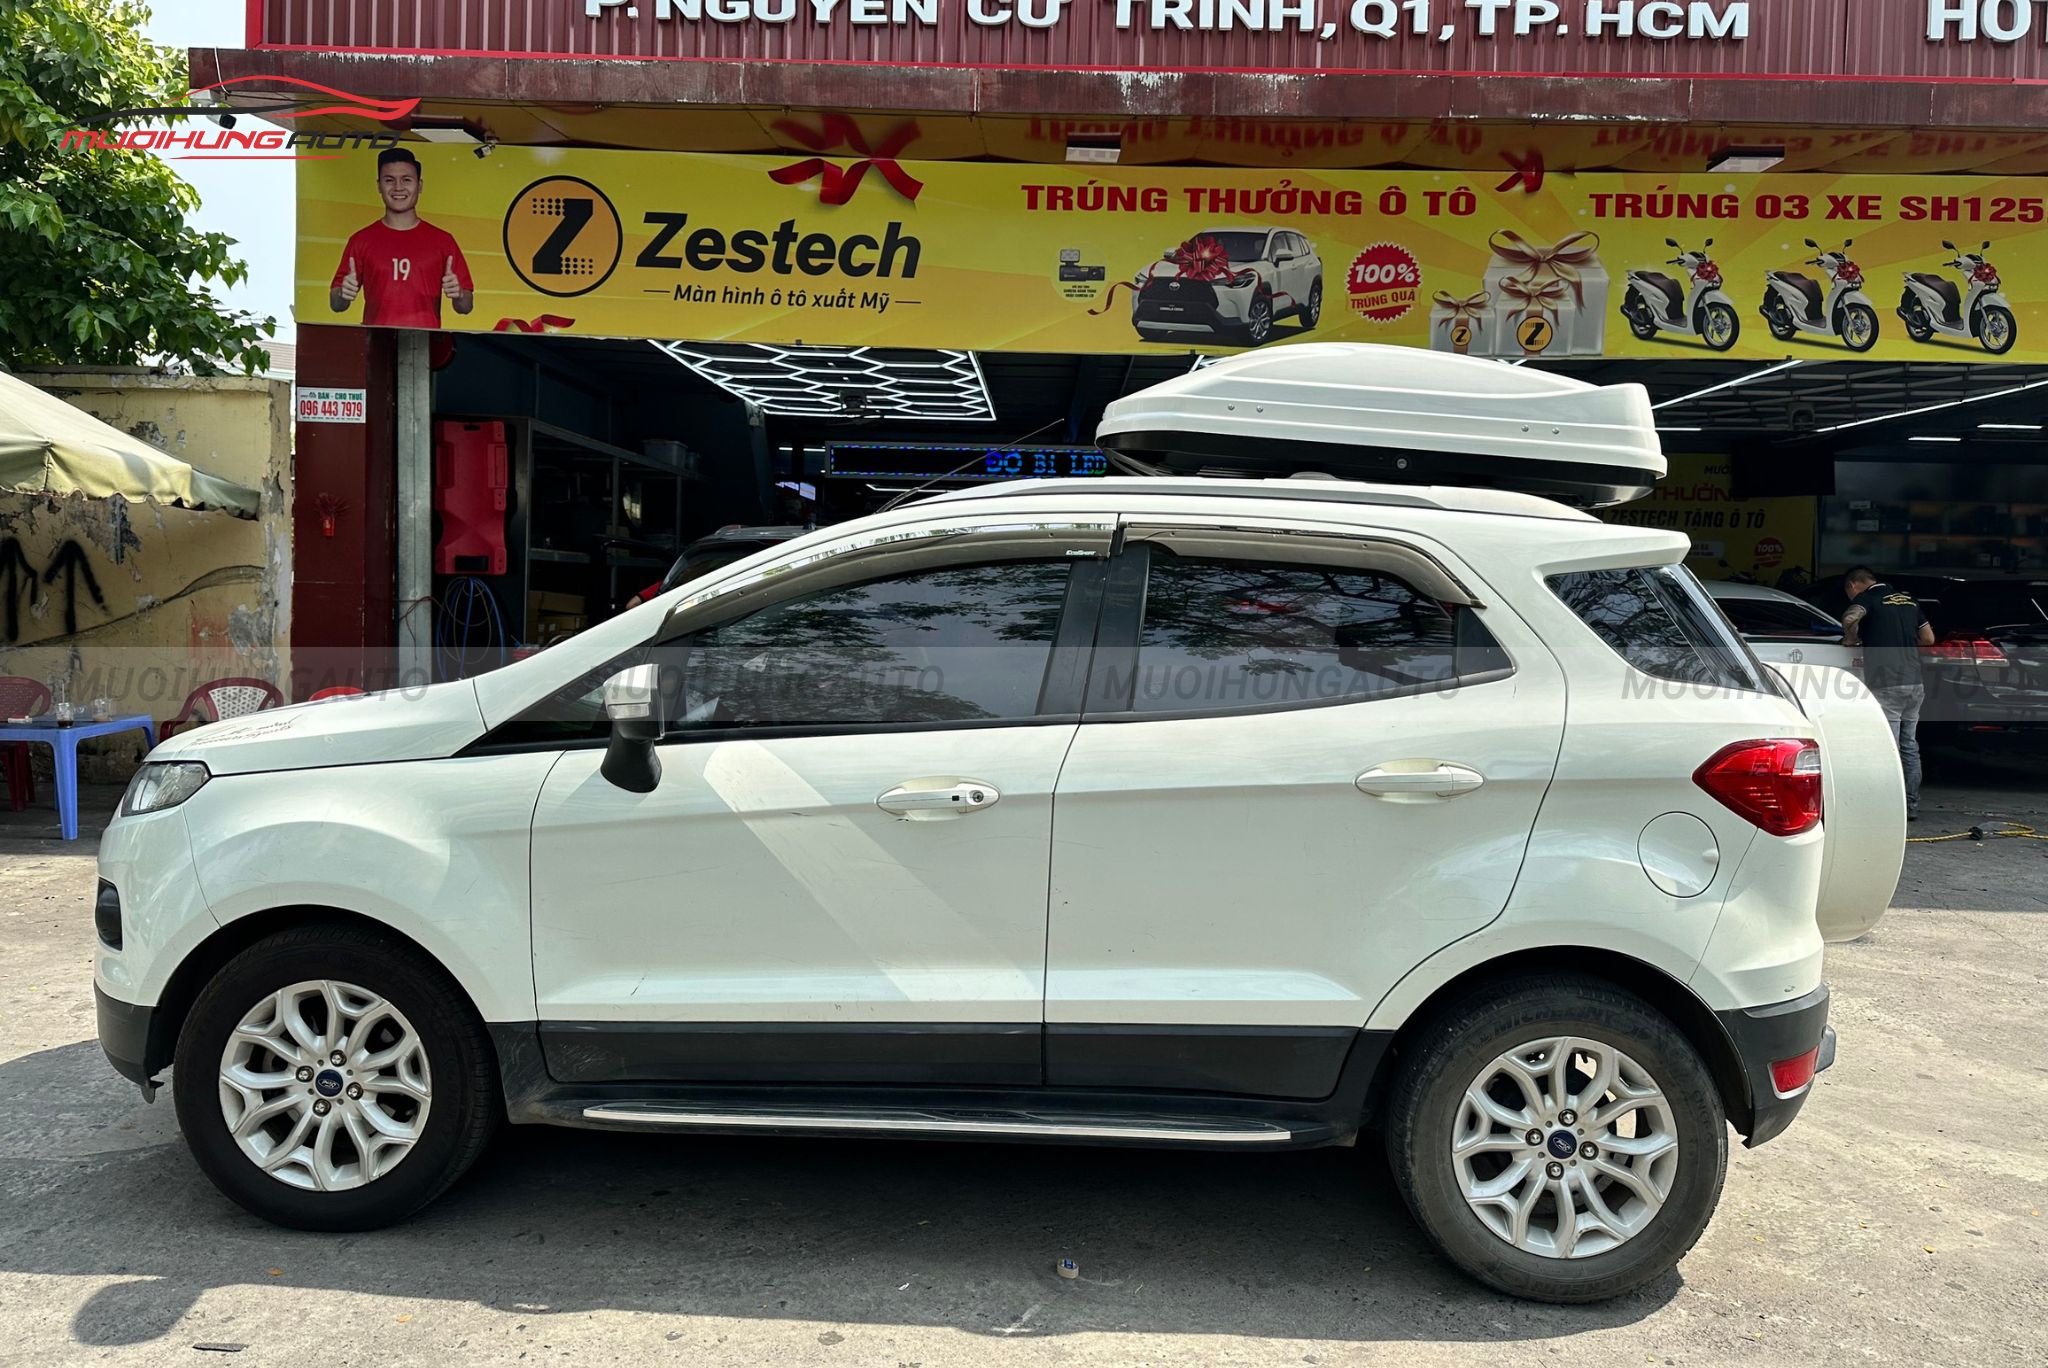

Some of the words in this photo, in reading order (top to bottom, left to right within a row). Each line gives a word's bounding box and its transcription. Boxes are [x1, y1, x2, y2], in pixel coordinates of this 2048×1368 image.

[1465, 0, 1568, 36] TP.
[1585, 0, 1750, 40] HCM
[1020, 179, 1169, 213] TRÚNG
[1183, 179, 1363, 216] THƯỞNG
[1378, 185, 1408, 217] Ô
[1422, 186, 1478, 217] TÔ
[1588, 184, 1740, 219] TRÚNG
[1755, 194, 1810, 220] 03
[1824, 195, 1883, 221] XE
[635, 211, 922, 279] Zestech
[392, 257, 411, 281] 19
[1355, 263, 1415, 284] 100%
[673, 284, 716, 302] Màn
[722, 286, 764, 305] hình
[770, 289, 782, 306] ô
[787, 290, 807, 307] tô
[812, 288, 856, 309] xuất
[860, 292, 890, 314] Mỹ
[1350, 293, 1389, 310] TRÚNG
[300, 399, 318, 416] 096
[321, 400, 339, 417] 443
[341, 401, 363, 417] 7979
[1746, 511, 1766, 529] TÔ
